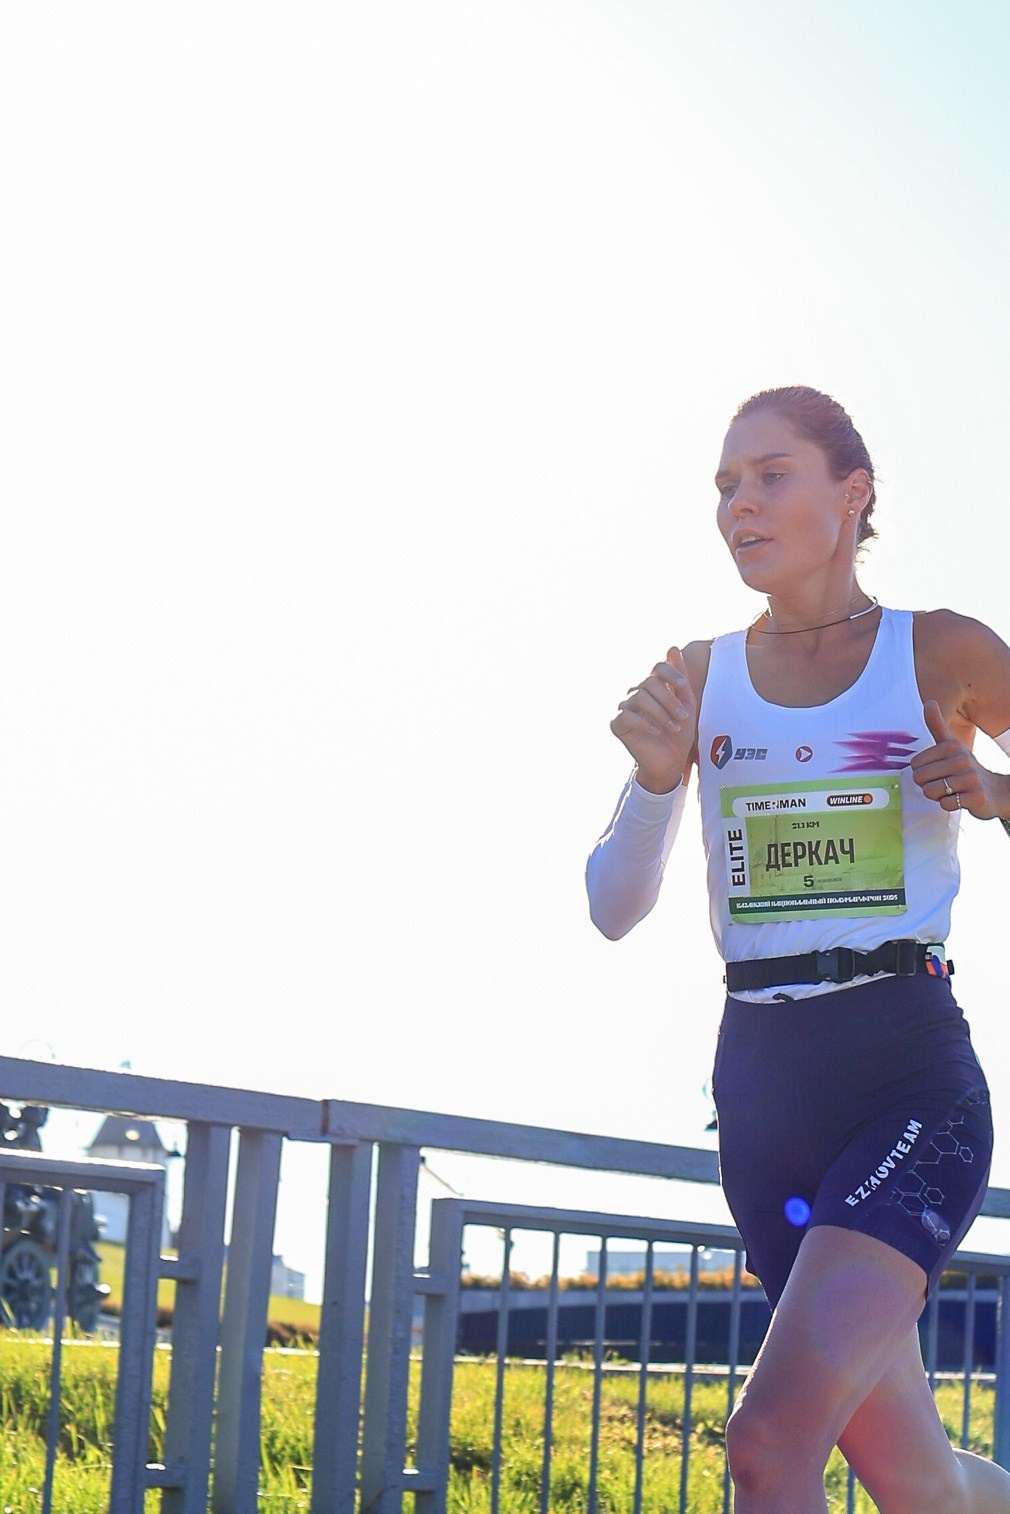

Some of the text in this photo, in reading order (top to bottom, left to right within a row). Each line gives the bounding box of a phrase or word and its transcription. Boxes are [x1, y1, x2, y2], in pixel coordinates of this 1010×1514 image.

[829, 795, 864, 805] WINLINE
[728, 828, 746, 887] ELITE
[765, 838, 855, 872] ДЕРКАЧ
[803, 875, 815, 888] 5
